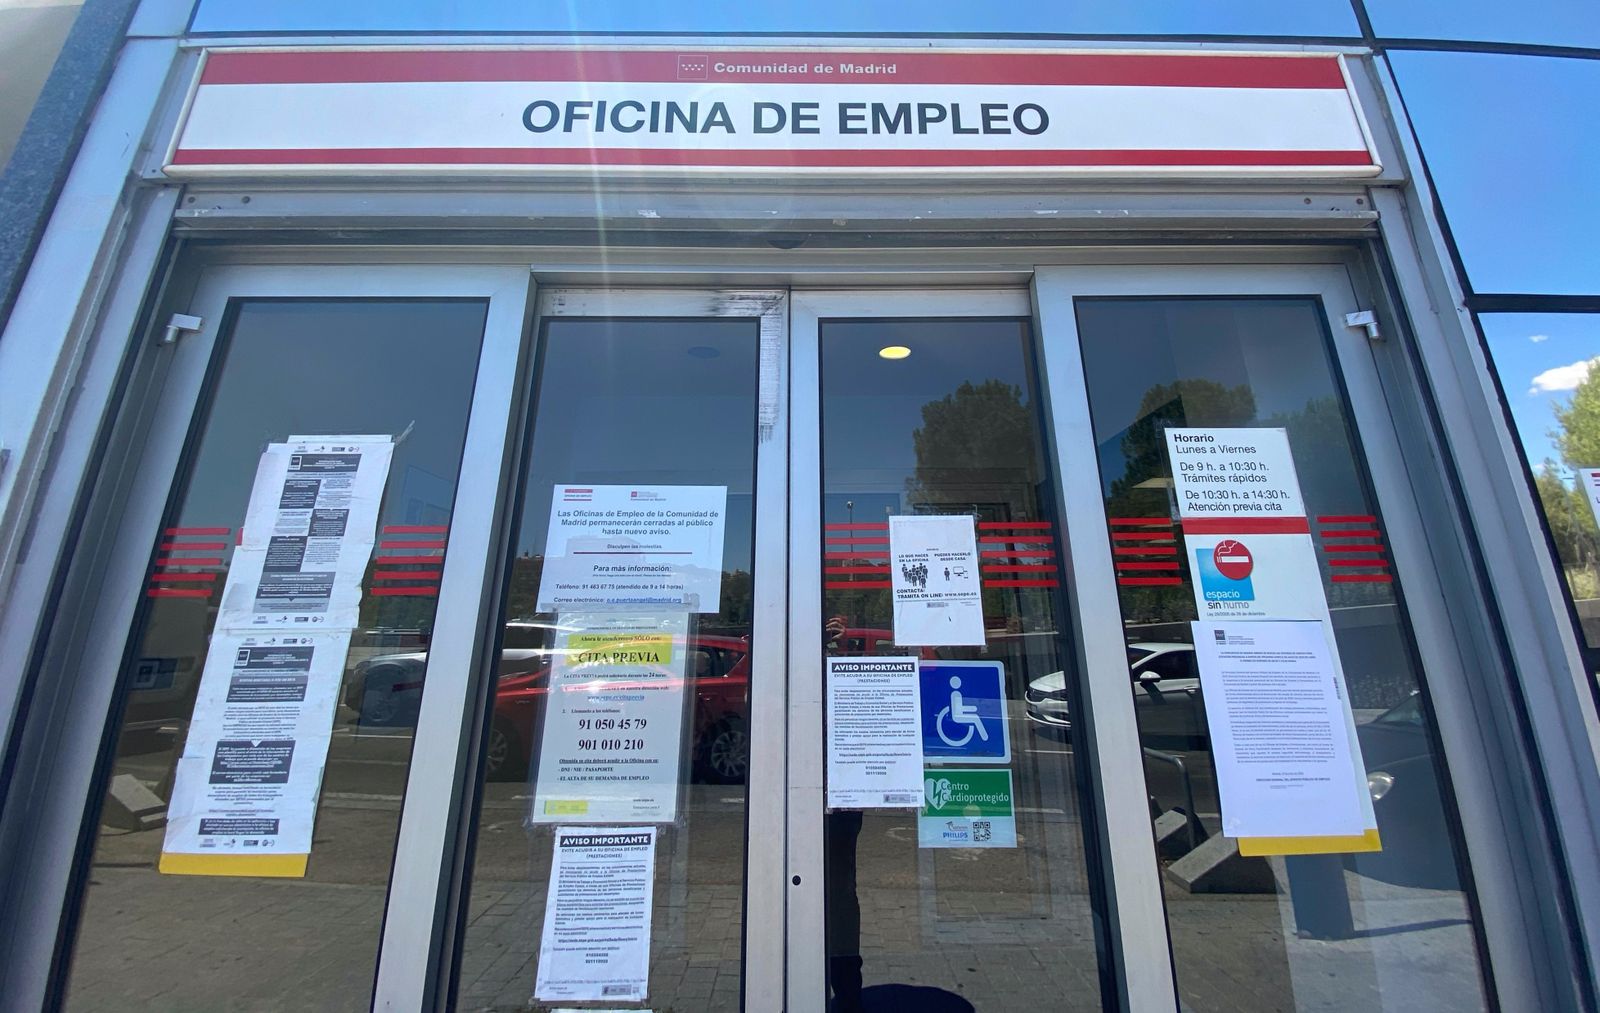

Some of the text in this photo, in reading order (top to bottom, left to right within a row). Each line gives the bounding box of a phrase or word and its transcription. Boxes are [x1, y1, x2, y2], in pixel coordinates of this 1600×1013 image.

[714, 62, 897, 74] Comunidad de Madrid
[522, 100, 1050, 135] OFICINA DE EMPLEO
[1173, 433, 1214, 443] Horario
[1176, 445, 1207, 454] Lunes
[1218, 445, 1257, 454] Viernes
[1180, 462, 1194, 471] De
[1197, 462, 1204, 471] 9
[1206, 462, 1216, 471] h.
[1229, 462, 1257, 471] 10:30
[1259, 462, 1270, 471] h.
[1182, 473, 1267, 484] Trámites rápidos
[1185, 490, 1200, 499] De
[1202, 490, 1229, 499] 10:30
[1231, 490, 1240, 499] h.
[1252, 490, 1278, 499] 14:30
[1280, 490, 1290, 499] h.
[1187, 502, 1282, 513] Atención previa cita
[557, 510, 571, 518] Las
[573, 510, 604, 518] Oficinas
[605, 510, 615, 518] de
[616, 510, 645, 519] Empleo
[646, 510, 656, 518] de
[657, 510, 664, 518] la
[665, 510, 708, 518] Comunidad
[561, 519, 713, 528] Madrid permanecerán cerradas al público
[1206, 590, 1240, 600] espacio
[1208, 600, 1250, 609] sin humo
[578, 652, 660, 663] CITA PREVIA
[578, 718, 647, 730] 91 050 45 79
[578, 739, 644, 750] 901 010 210
[941, 781, 969, 790] Centro
[941, 792, 1009, 804] Cardioprotegido
[563, 836, 648, 845] AVISO IMPORTANTE
